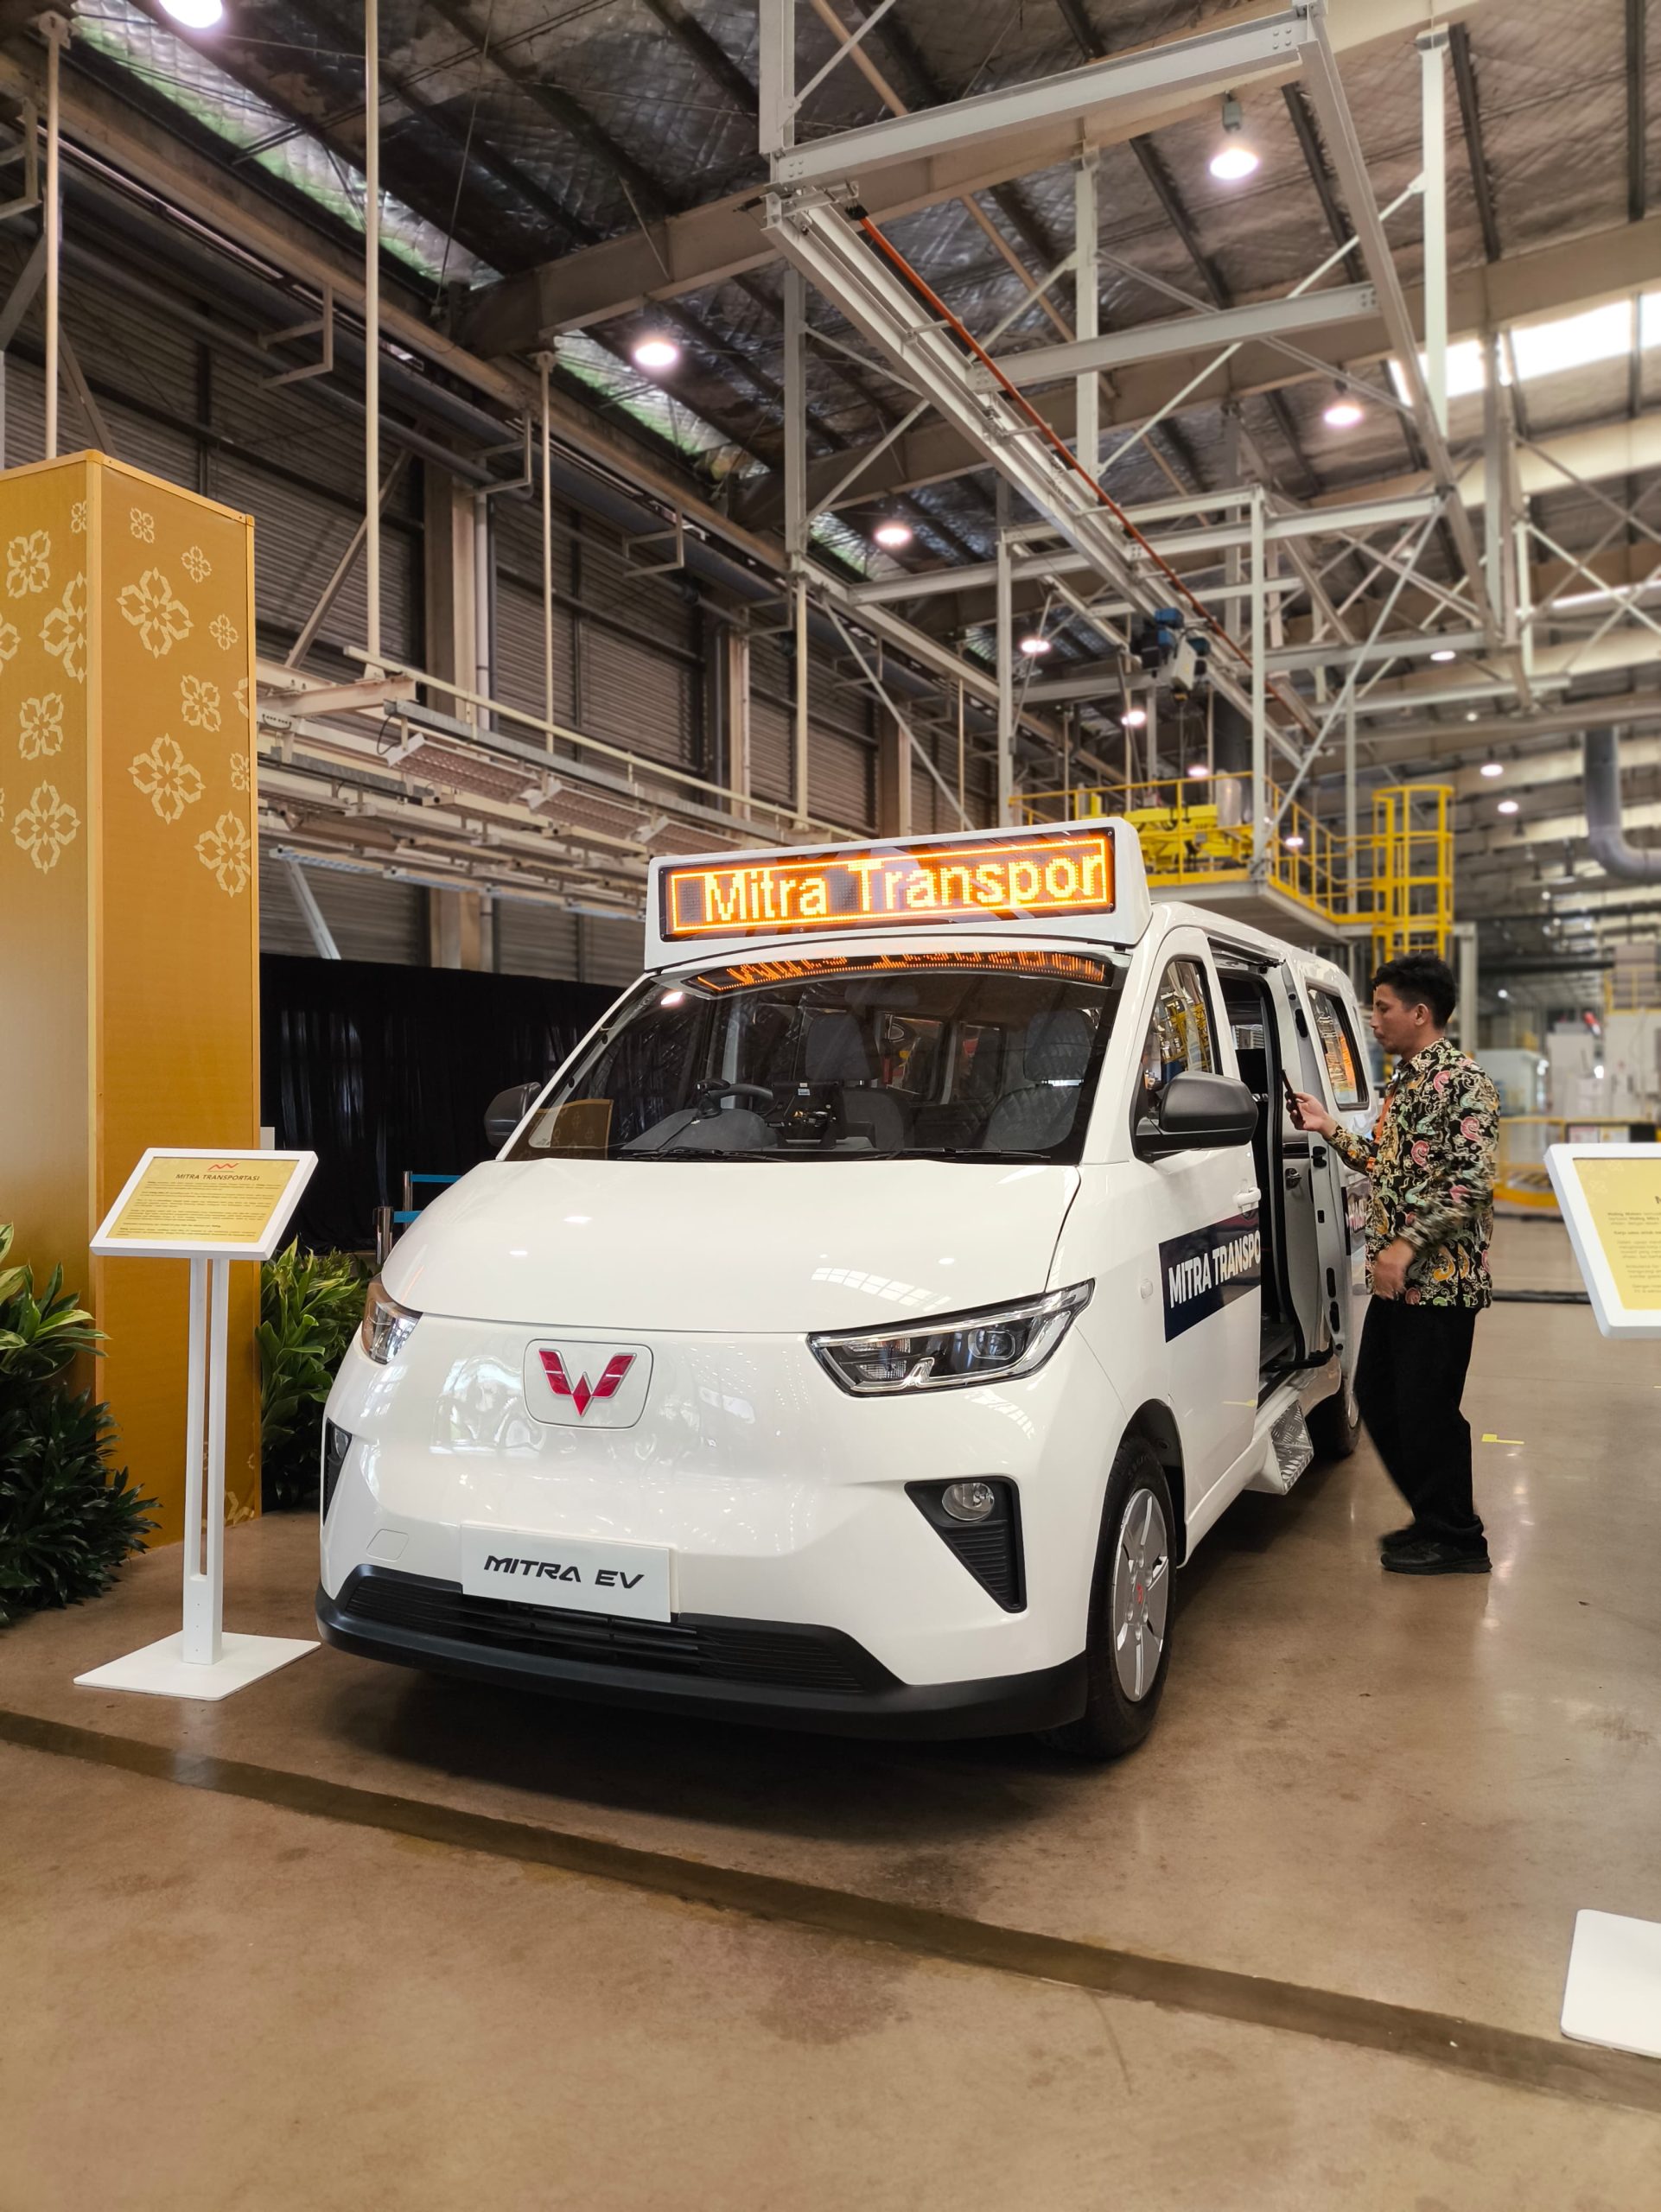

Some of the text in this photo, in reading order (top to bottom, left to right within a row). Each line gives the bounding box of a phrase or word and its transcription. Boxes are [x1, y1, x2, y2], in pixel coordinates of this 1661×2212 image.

[703, 853, 1104, 922] Mitra Transpor
[1168, 1230, 1261, 1309] MITRA TRANSPO
[484, 1554, 645, 1590] MITRA EV
